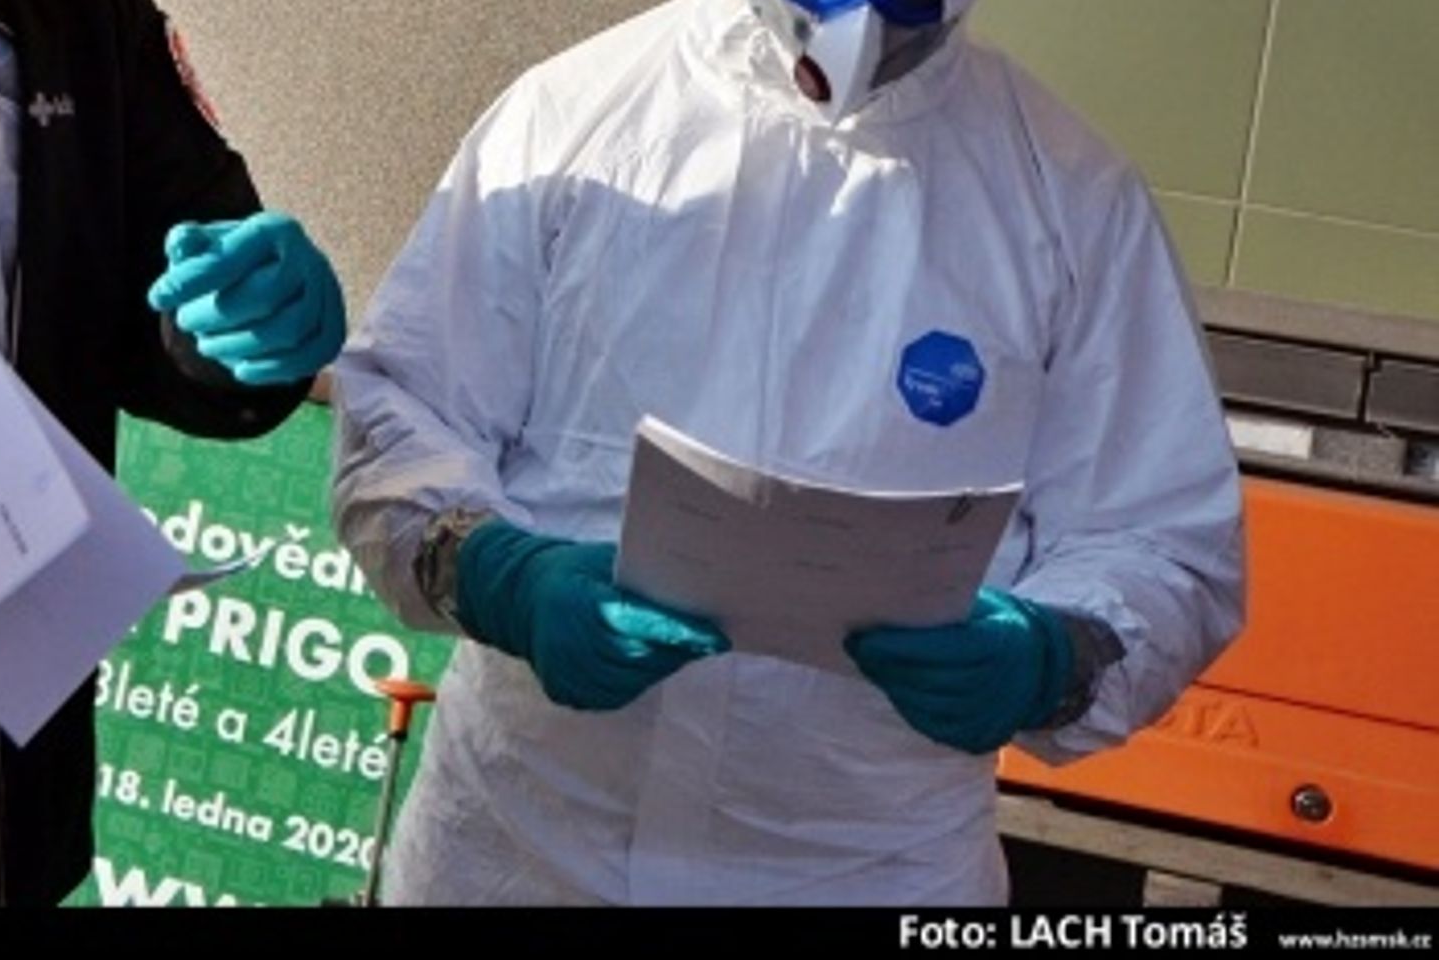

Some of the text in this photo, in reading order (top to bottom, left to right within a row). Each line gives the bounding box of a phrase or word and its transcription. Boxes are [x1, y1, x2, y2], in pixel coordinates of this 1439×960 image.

[140, 500, 375, 597] dověd
[163, 590, 409, 697] PRIGO
[216, 710, 248, 744] a
[264, 709, 388, 780] 4leté
[162, 779, 272, 842] ledna
